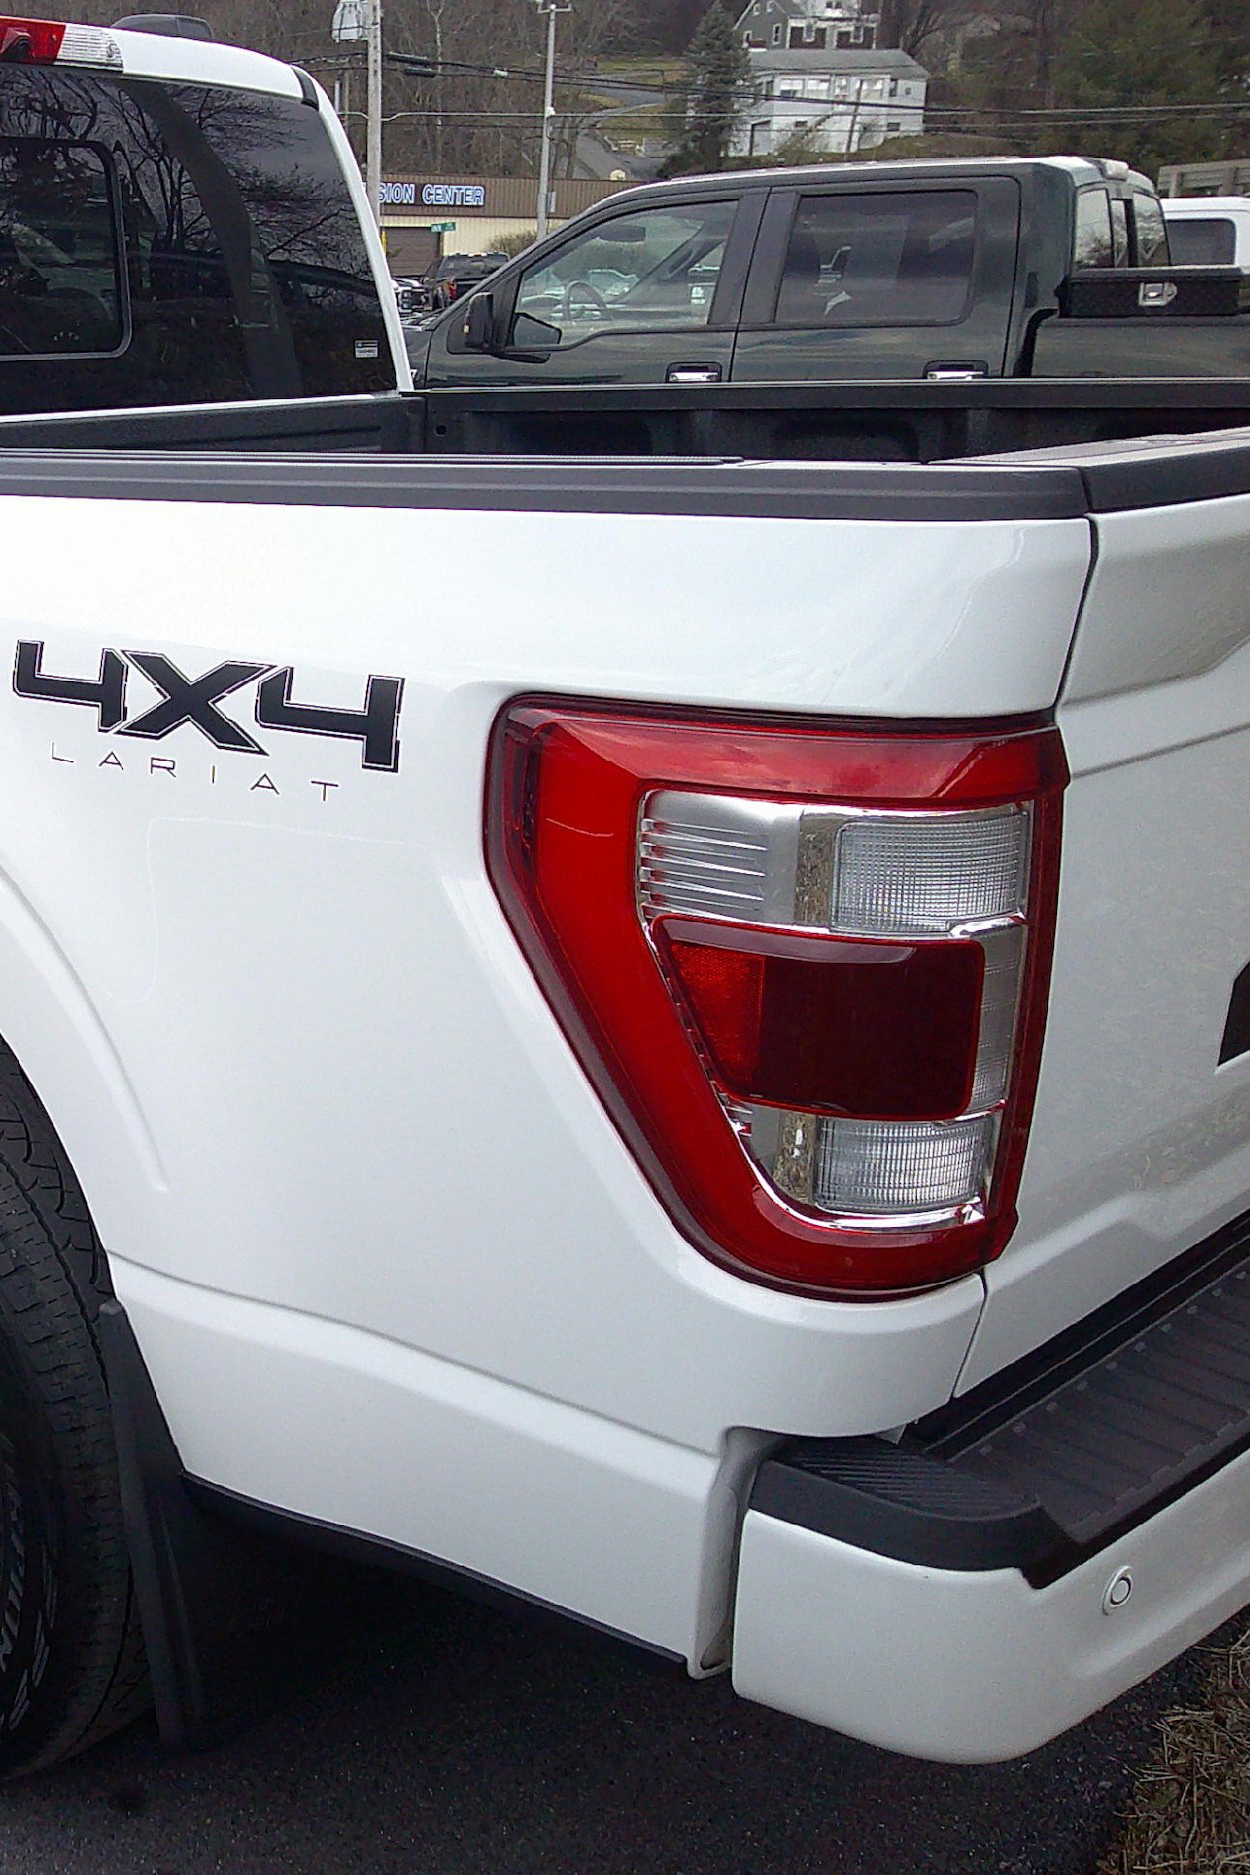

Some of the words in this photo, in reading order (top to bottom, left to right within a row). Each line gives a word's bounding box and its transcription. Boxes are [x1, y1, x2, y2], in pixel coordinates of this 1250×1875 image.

[378, 182, 416, 204] SION
[422, 184, 485, 205] CENTER
[12, 639, 406, 773] 4X4
[51, 741, 339, 802] LARIAT
